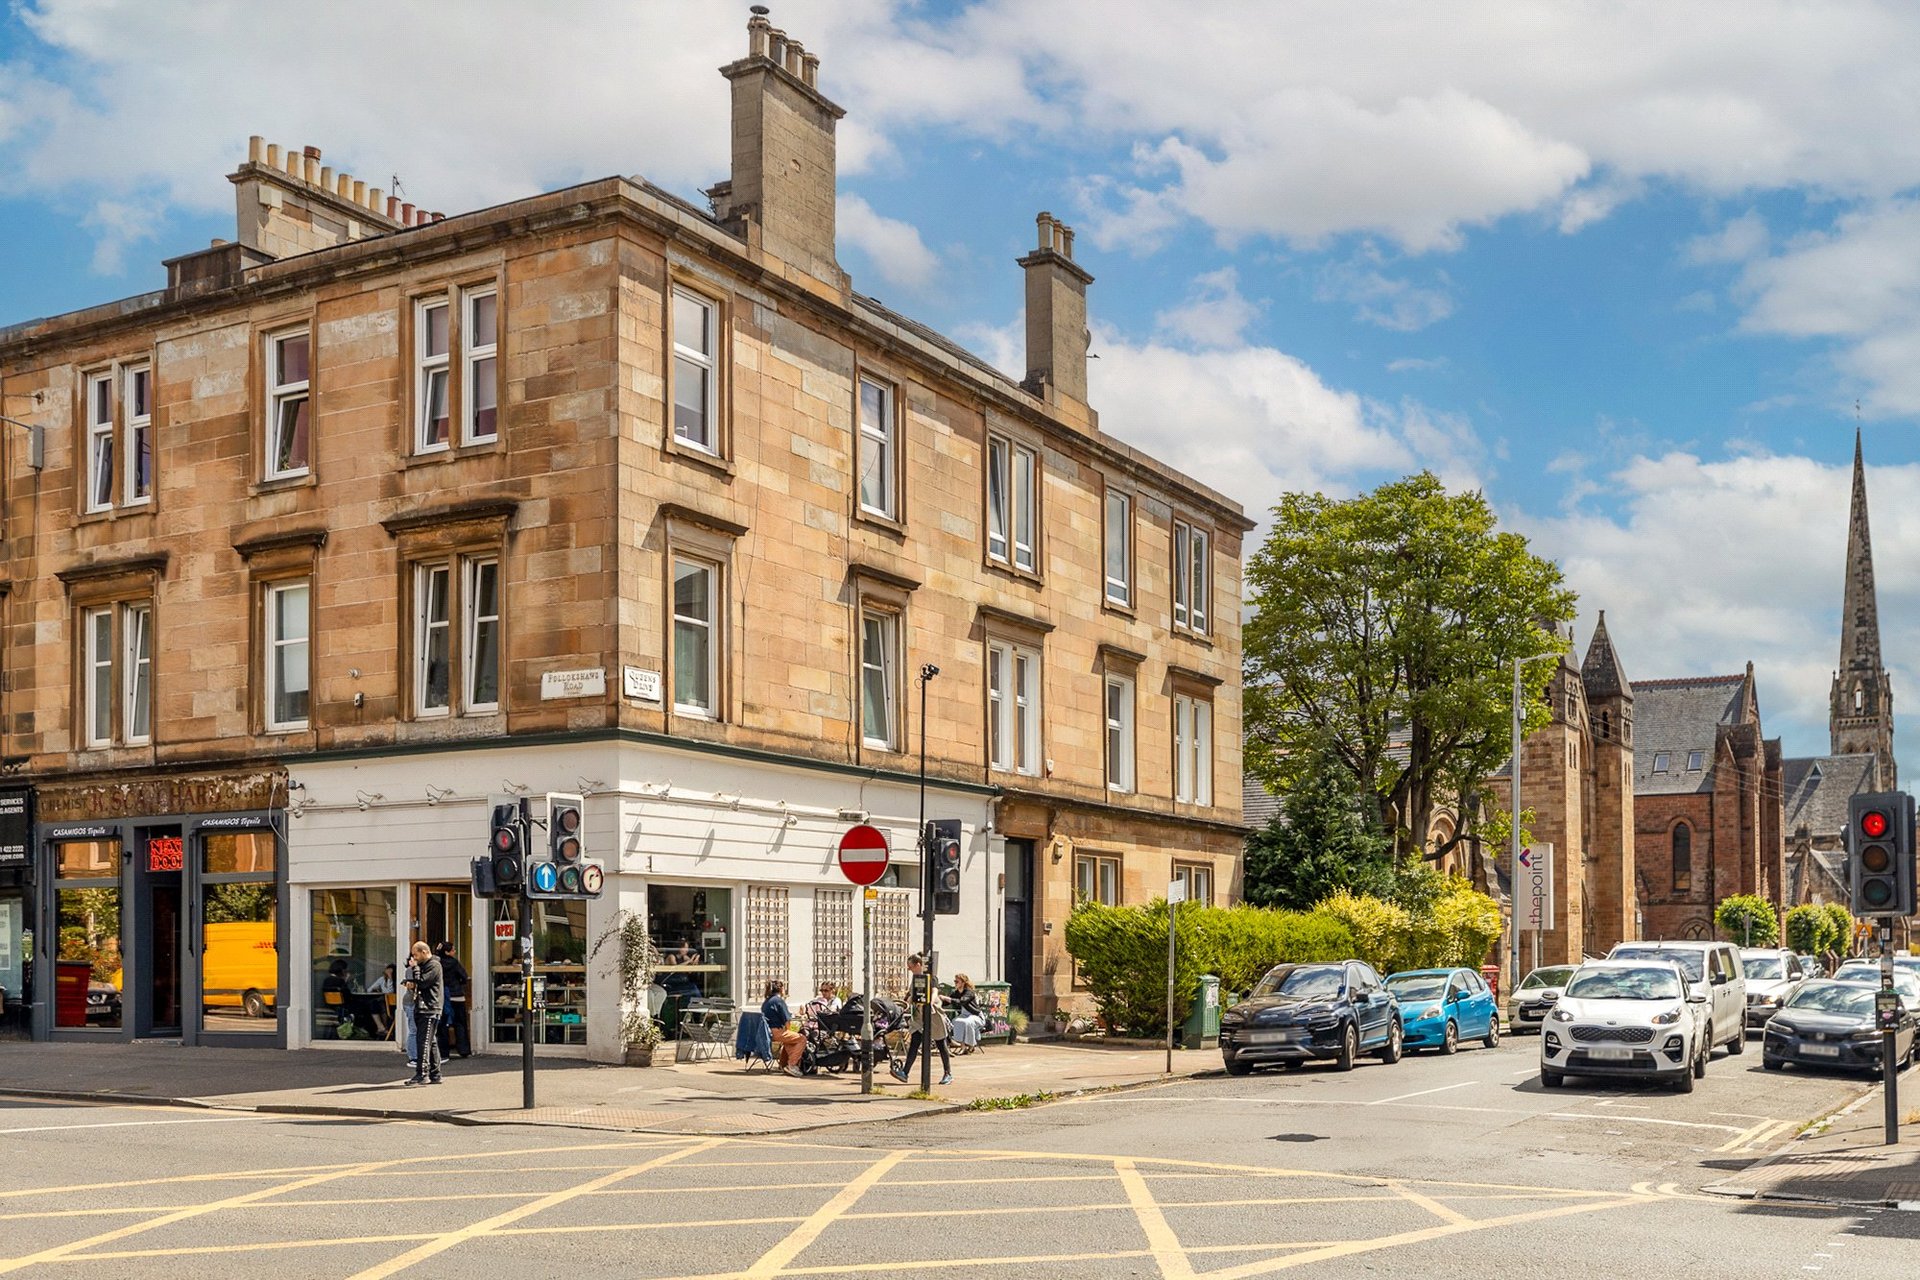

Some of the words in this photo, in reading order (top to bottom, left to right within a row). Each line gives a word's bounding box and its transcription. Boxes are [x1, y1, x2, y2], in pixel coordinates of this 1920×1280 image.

[547, 672, 599, 683] POLLOKSHAWS
[629, 670, 656, 684] QUEENS
[563, 682, 584, 691] ROAD
[201, 818, 240, 826] CASAMIGOS
[53, 827, 86, 836] CASAMIGOS
[496, 924, 514, 937] OPEN
